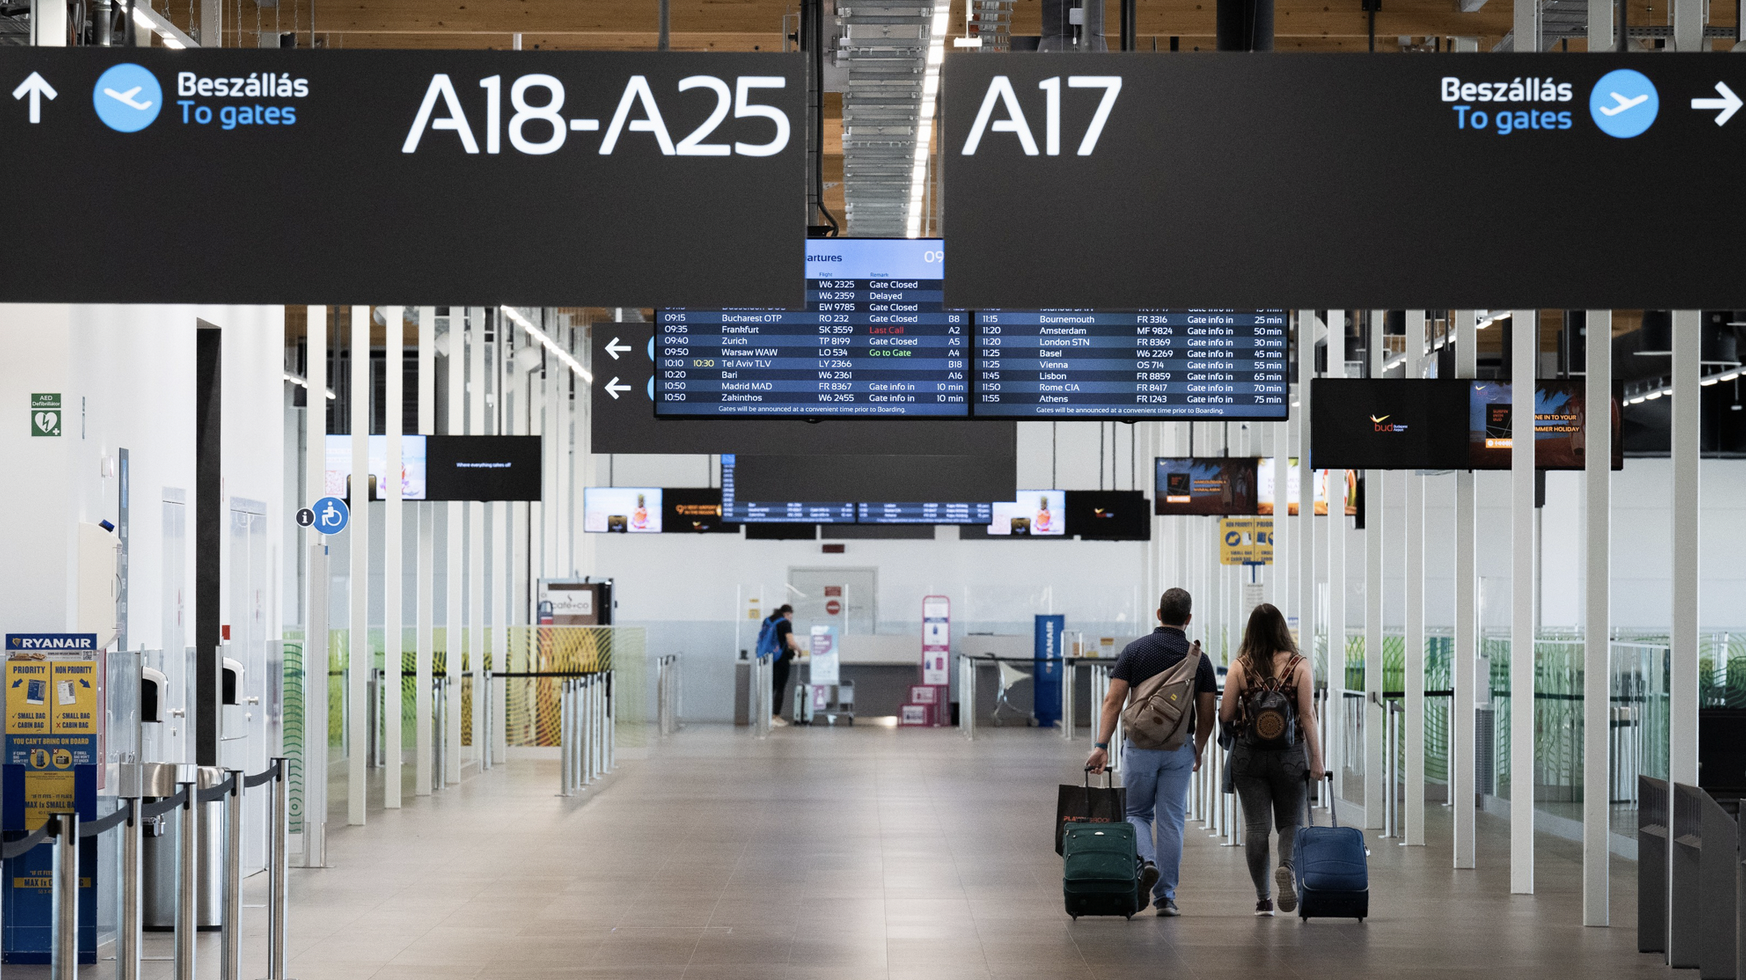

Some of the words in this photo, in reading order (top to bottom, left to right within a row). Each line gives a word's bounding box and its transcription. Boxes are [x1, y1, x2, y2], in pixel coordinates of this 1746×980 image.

[178, 72, 309, 97] Beszállás
[1441, 77, 1573, 102] Beszállás
[176, 100, 212, 124] To
[219, 104, 297, 130] gates
[402, 74, 790, 156] A18-A25
[961, 75, 1122, 156] A17
[1452, 105, 1488, 130] To
[1496, 109, 1573, 135] gates
[807, 254, 842, 262] artures
[870, 292, 902, 301] Delayed
[722, 314, 762, 322] Bucharest
[1374, 423, 1393, 432] bud
[22, 638, 91, 648] RYANAIR
